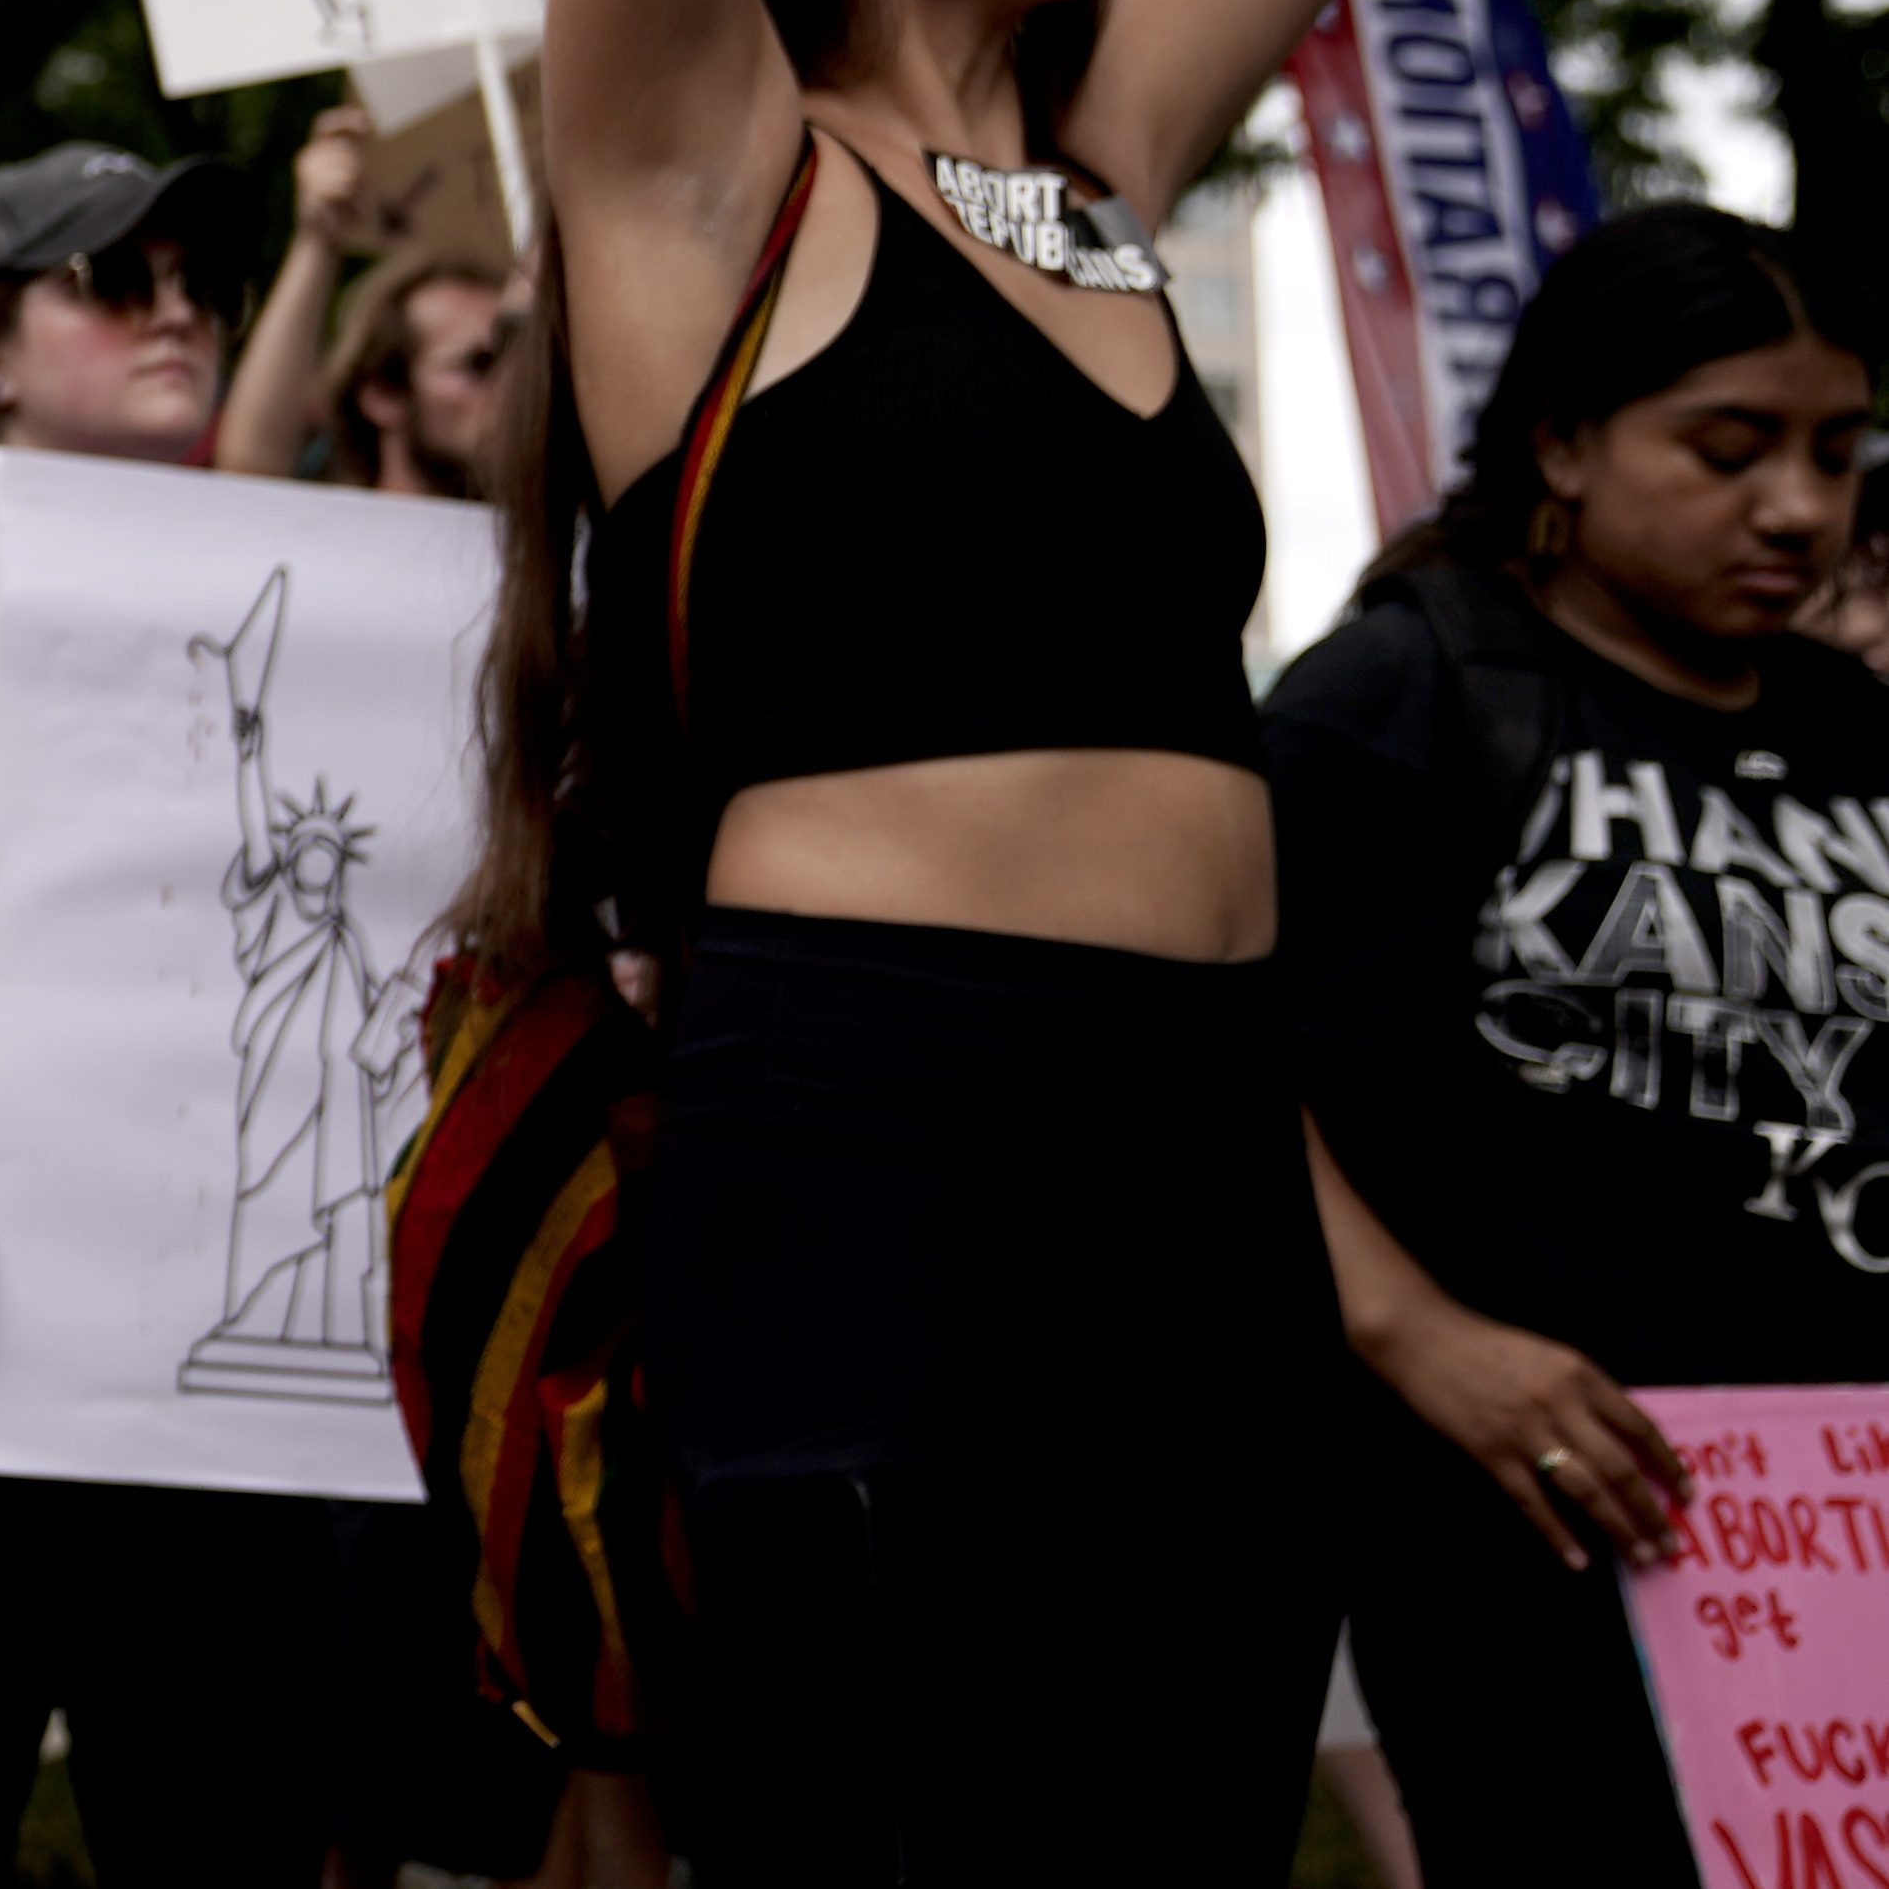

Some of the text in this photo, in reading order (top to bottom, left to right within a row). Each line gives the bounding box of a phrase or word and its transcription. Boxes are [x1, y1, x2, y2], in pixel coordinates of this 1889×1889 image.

[935, 155, 1068, 221] ABORT
[1473, 979, 1875, 1143] CITY
[1695, 1587, 1800, 1662] get
